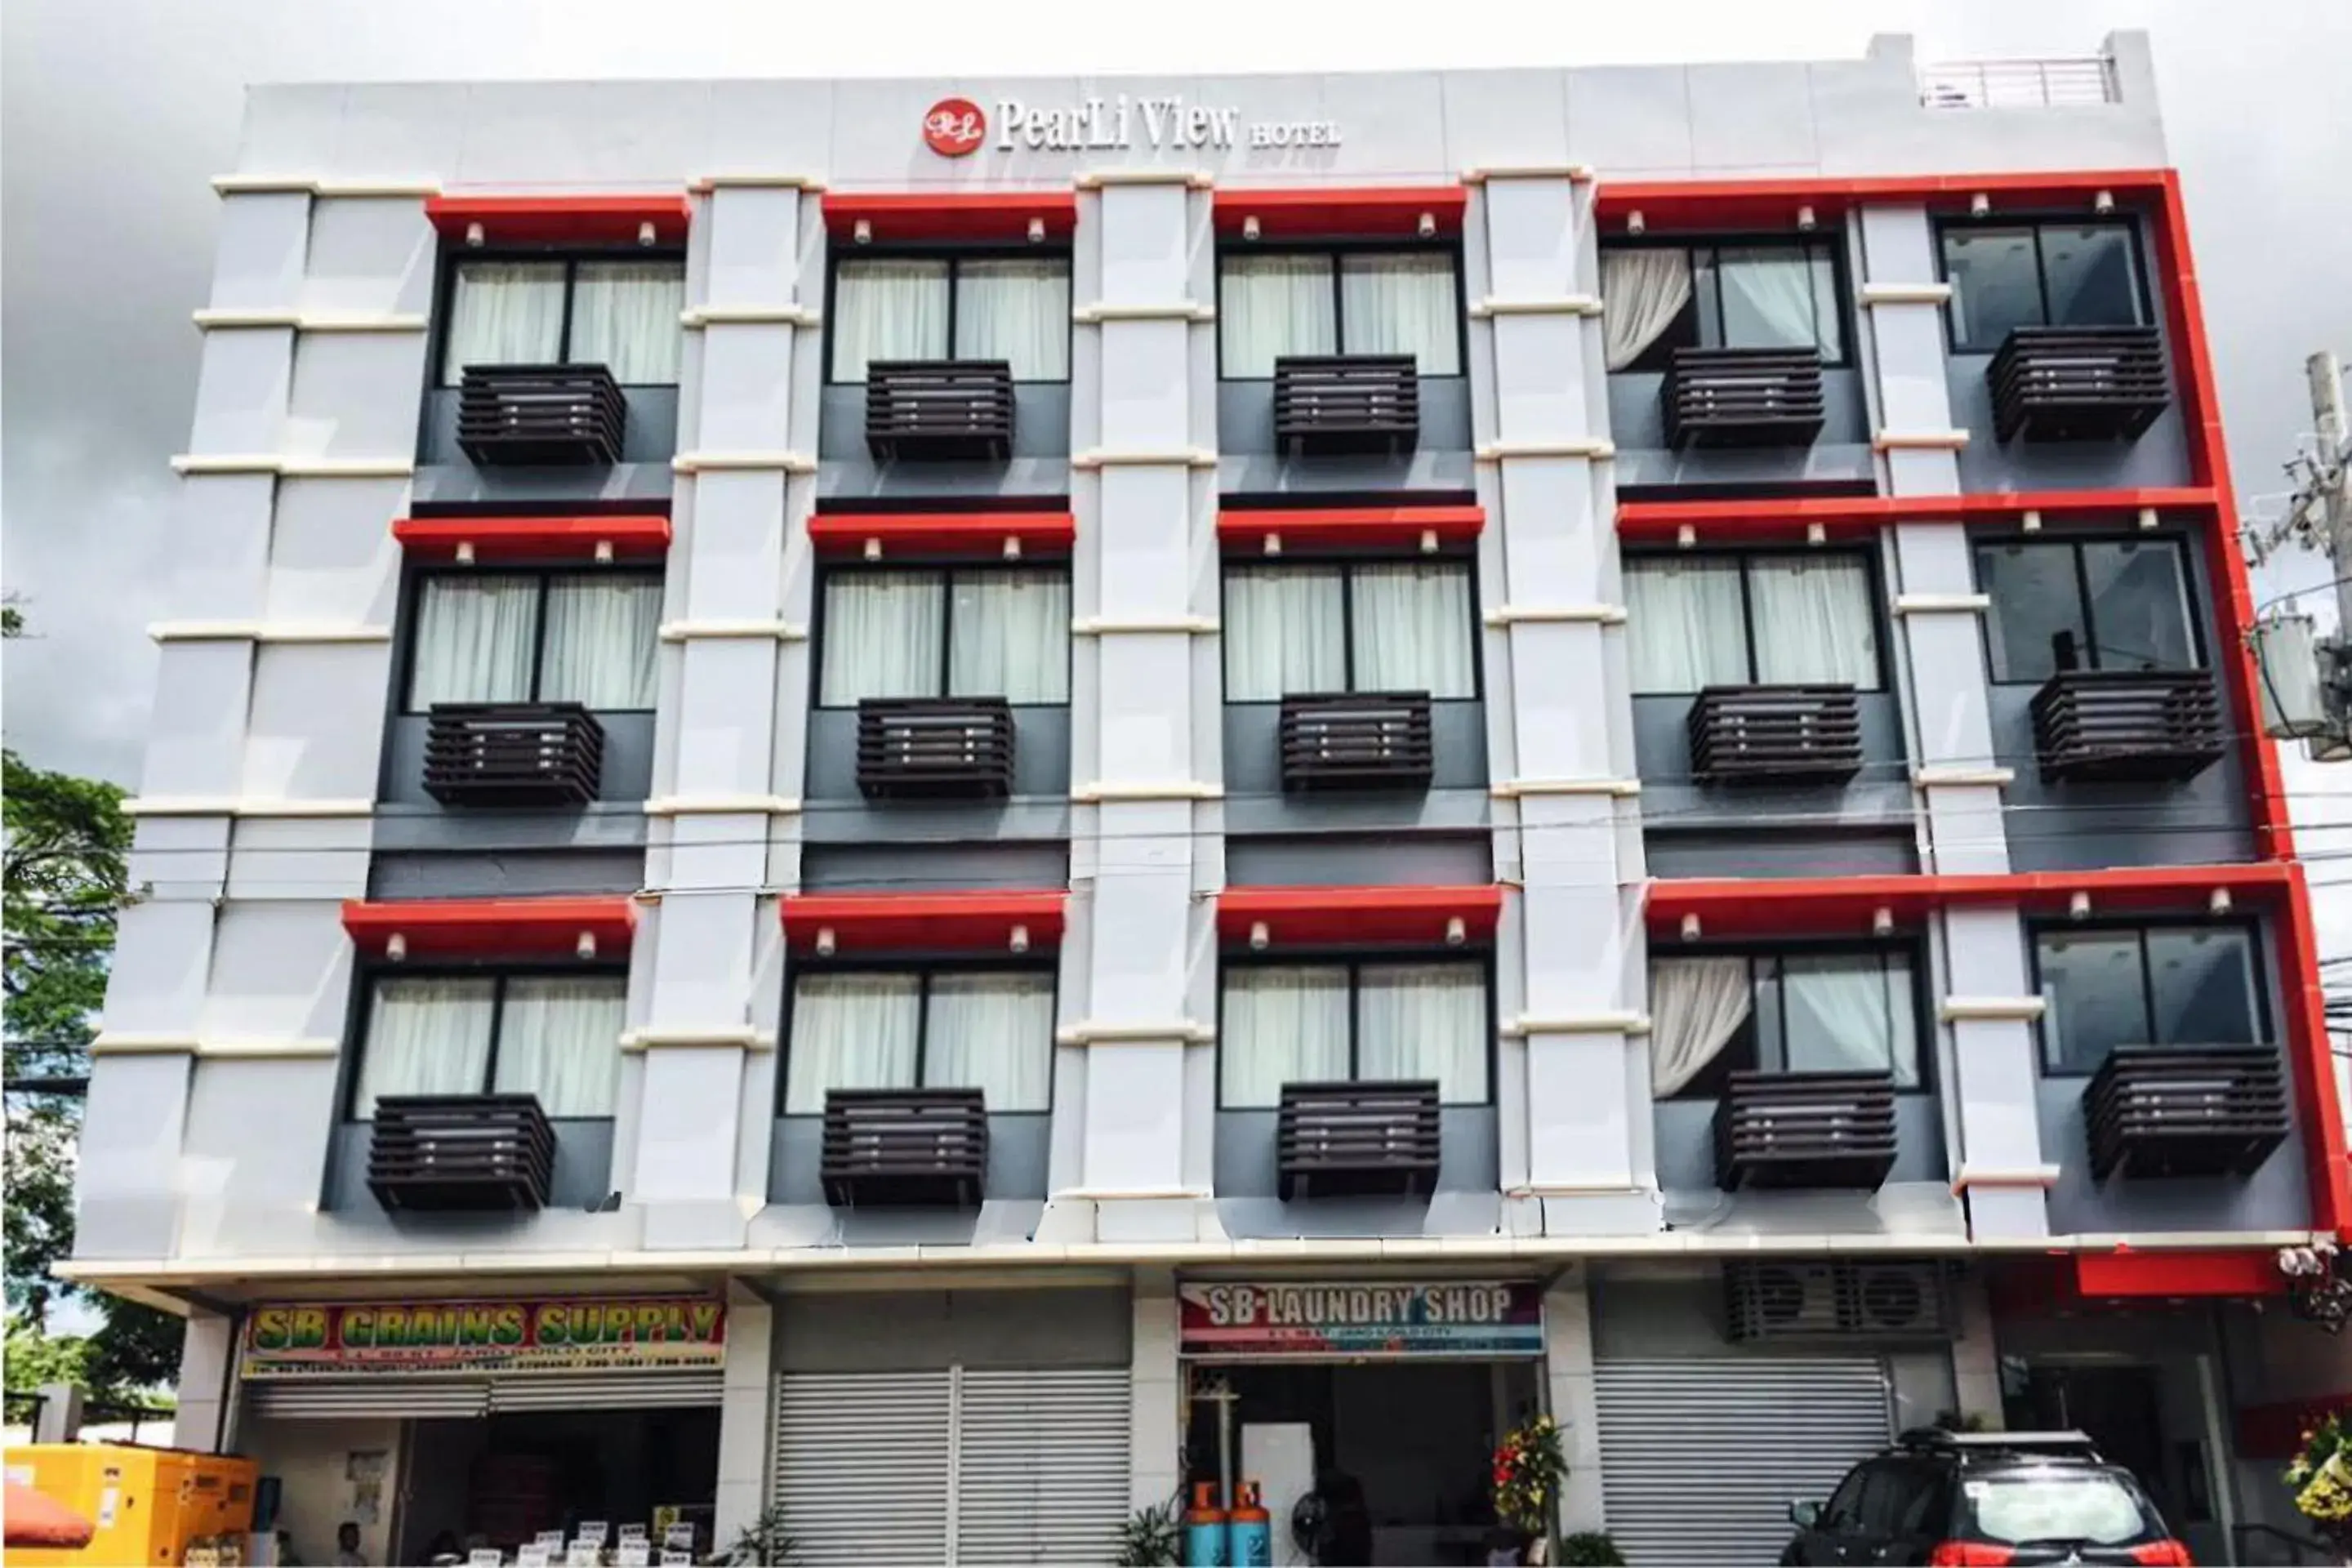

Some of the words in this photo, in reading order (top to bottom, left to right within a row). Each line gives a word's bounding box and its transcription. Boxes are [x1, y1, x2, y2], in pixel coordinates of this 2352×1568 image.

[996, 94, 1130, 151] PearLi
[1137, 93, 1241, 151] View
[1250, 121, 1342, 149] HOTEL
[252, 1307, 325, 1348] SB
[341, 1304, 526, 1348] GRAINS
[534, 1302, 719, 1346] SUPPLY
[1209, 1286, 1255, 1325] SB
[1266, 1288, 1414, 1324] LAUNDRY
[1424, 1287, 1512, 1322] SHOP
